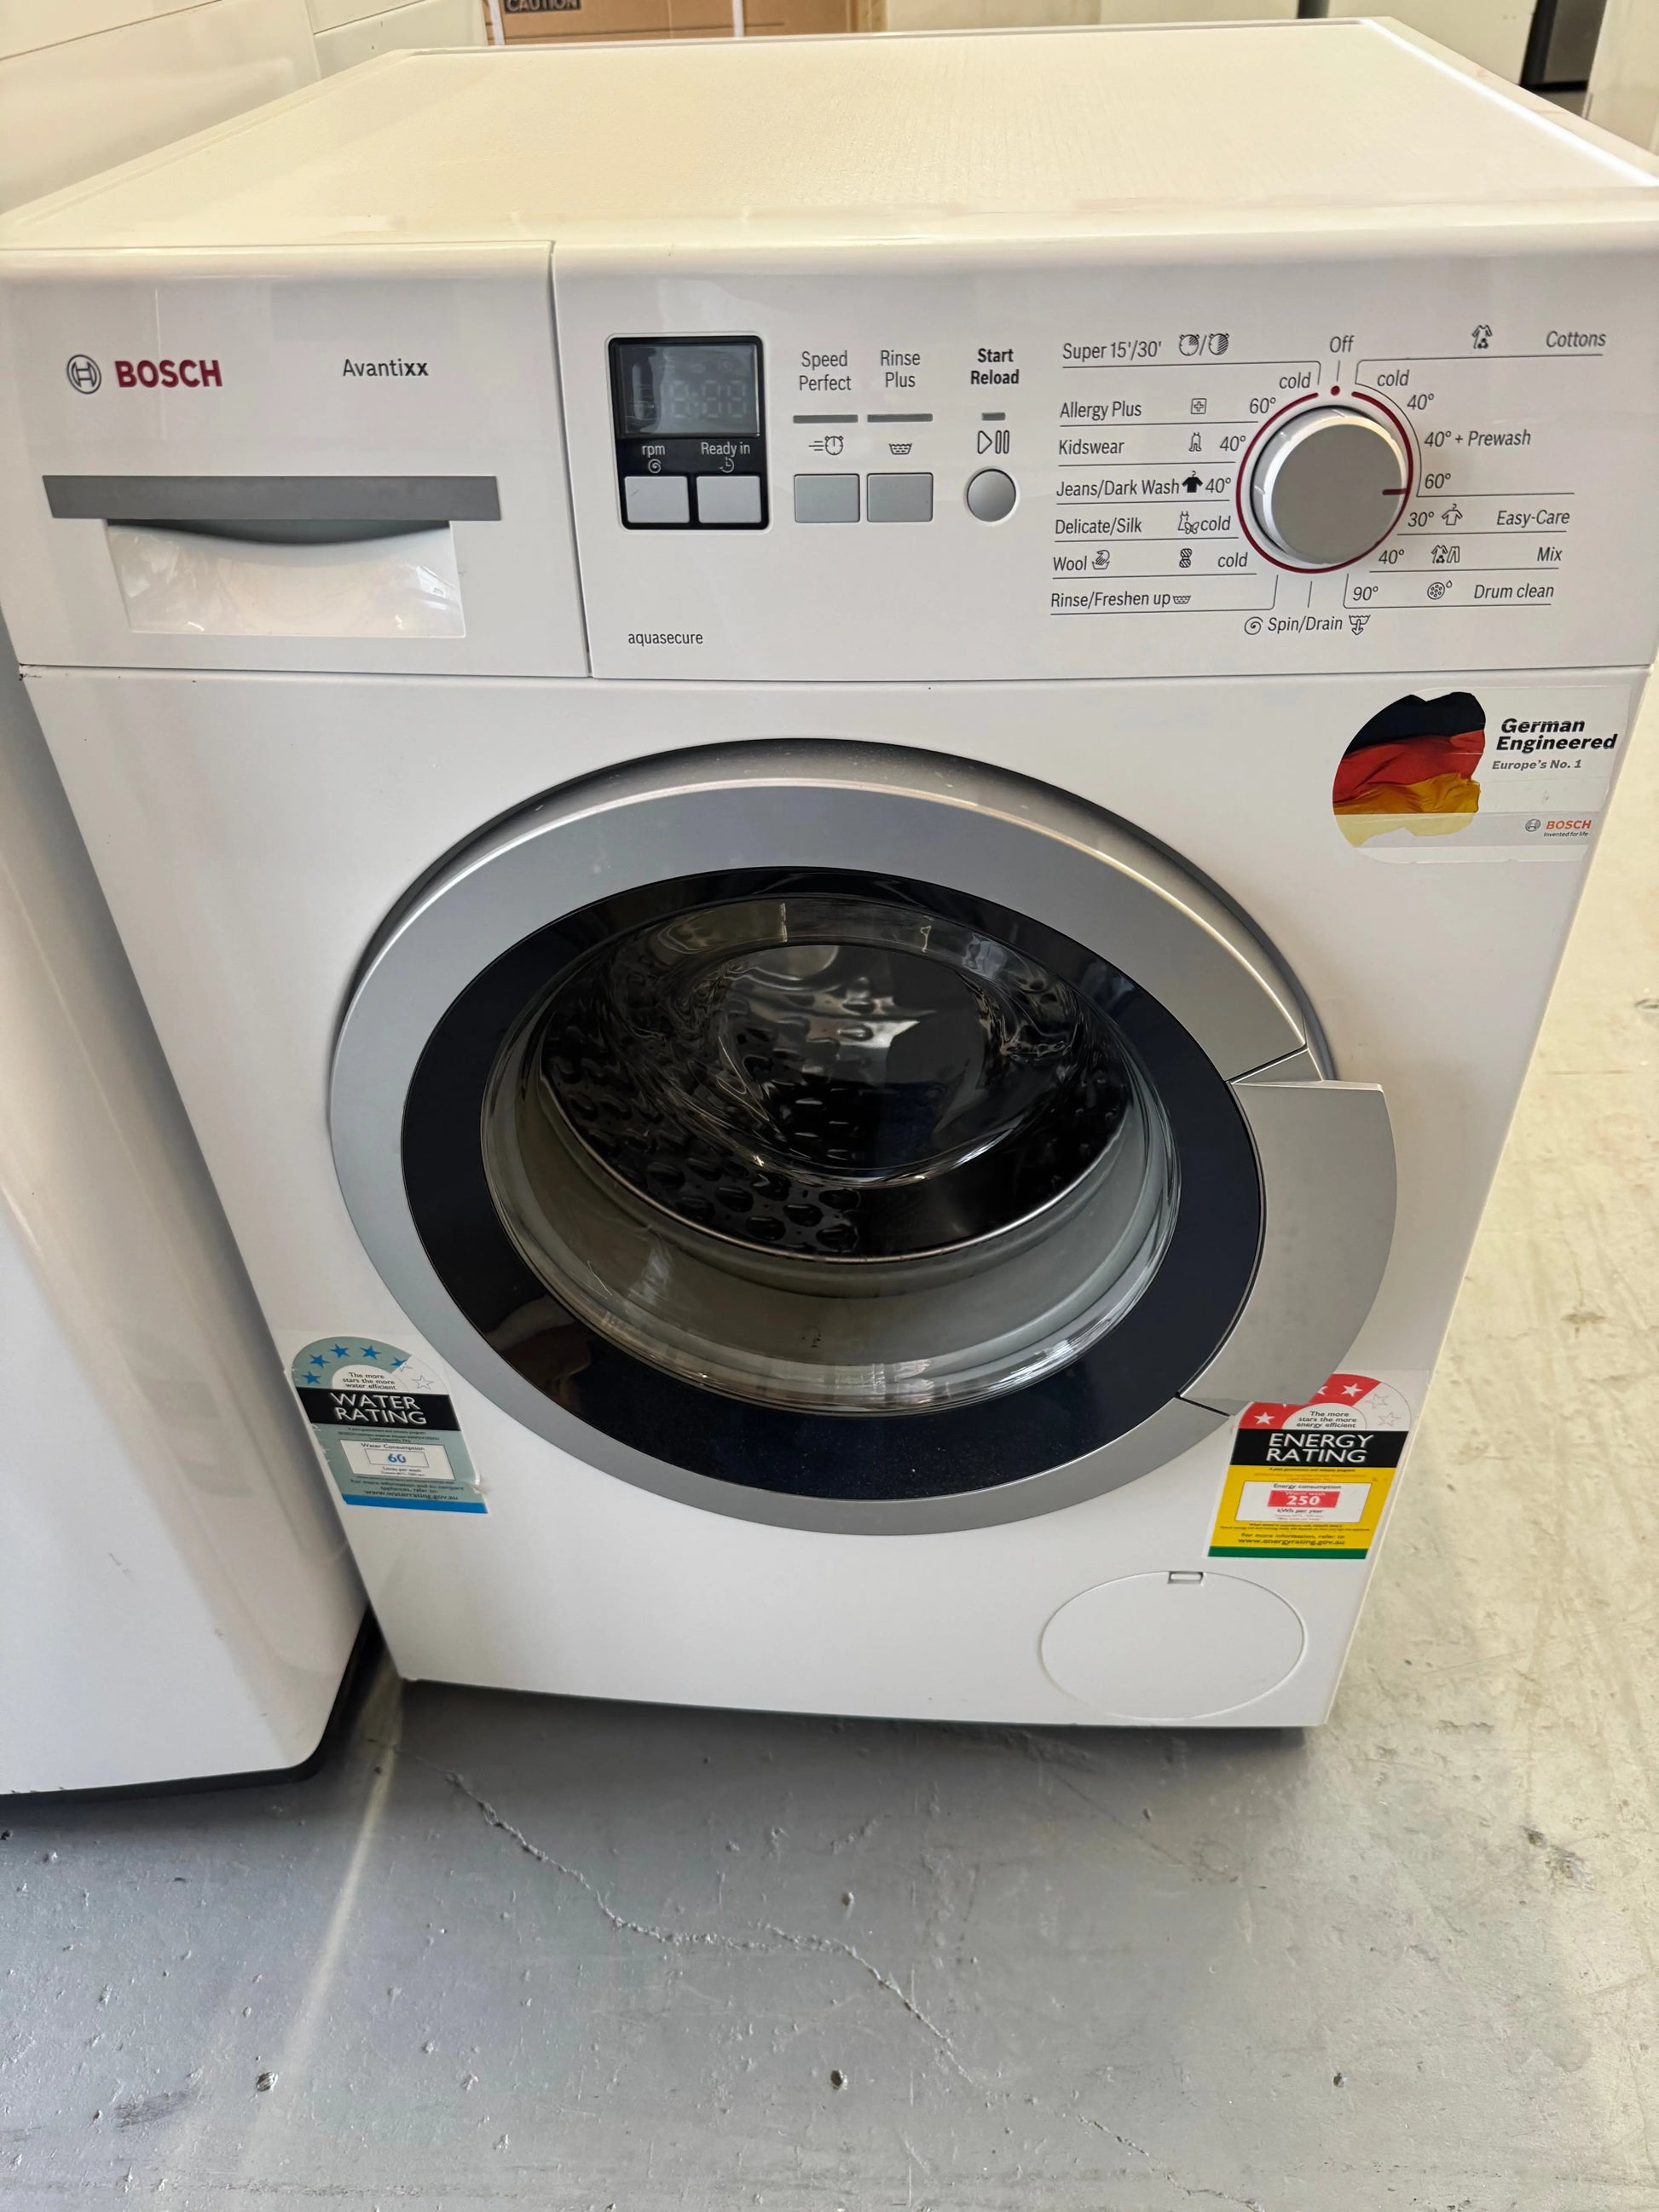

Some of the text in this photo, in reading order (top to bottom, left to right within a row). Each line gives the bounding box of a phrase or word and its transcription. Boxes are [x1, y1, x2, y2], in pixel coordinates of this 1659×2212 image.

[1329, 335, 1355, 353] Off
[1546, 331, 1606, 348] Cottons
[801, 350, 847, 370] Speed
[881, 349, 921, 366] Rinse
[977, 348, 1014, 363] Start
[1062, 343, 1107, 362] Super
[114, 360, 223, 388] BOSCH
[343, 359, 429, 377] Avantixx
[799, 375, 852, 390] Perfect
[885, 372, 916, 388] Plus
[970, 369, 1020, 384] Reload
[1279, 373, 1311, 390] cold
[1377, 369, 1409, 386] cold
[1060, 401, 1142, 420] Allergy Plus
[1454, 436, 1463, 444] +
[1468, 429, 1531, 447] Prewash
[642, 445, 666, 459] rpm
[701, 442, 750, 456] Ready in
[1059, 439, 1124, 455] Kidswear
[1056, 479, 1180, 497] Jeans/Dark Wash
[1055, 517, 1142, 535] Delicate/Silk
[1200, 516, 1231, 531] cold
[1496, 510, 1570, 528] Easy-Care
[1217, 552, 1248, 568] cold
[1537, 546, 1563, 562] Mix
[1053, 555, 1087, 571] Wool
[1474, 583, 1554, 599] Drum clean
[1051, 591, 1171, 609] Rinse/Freshen up
[1268, 615, 1343, 634] Spin/Drain
[627, 633, 703, 647] aquasecure
[1501, 718, 1586, 734] German
[1496, 733, 1618, 754] Engineered
[1492, 759, 1582, 771] Europe's No. 1
[1546, 820, 1592, 830] BOSCH
[329, 1392, 421, 1410] WATER
[334, 1406, 427, 1424] RATING
[1269, 1433, 1374, 1448] ENERGY
[387, 1453, 407, 1464] 60
[1266, 1448, 1367, 1464] RATING
[1286, 1495, 1321, 1505] 250
